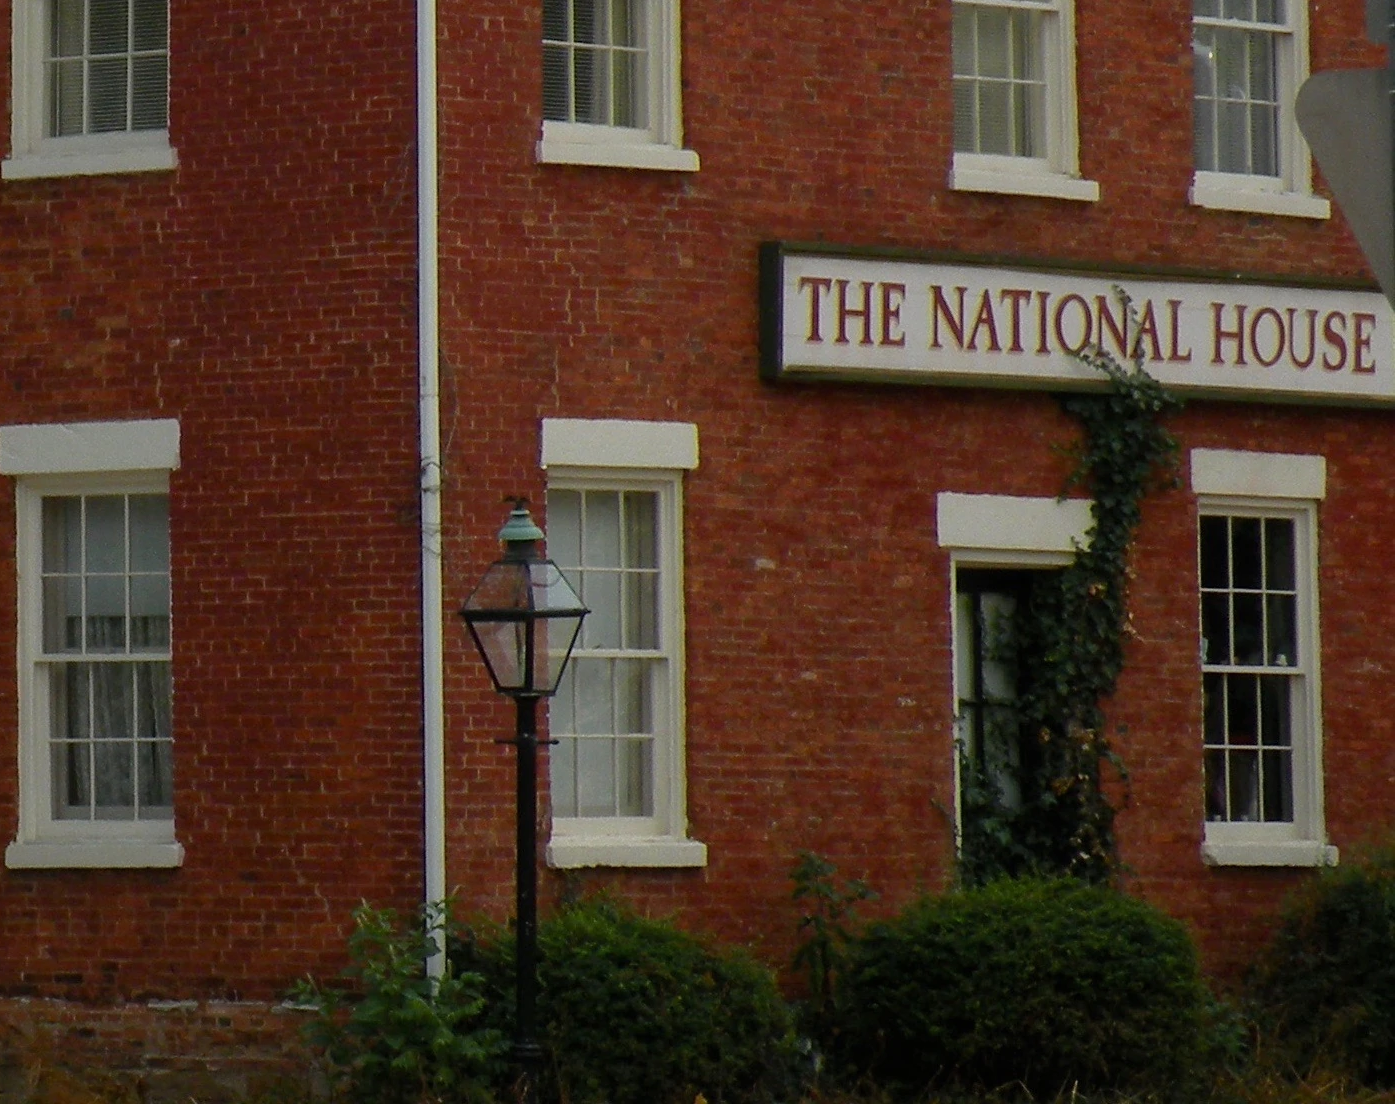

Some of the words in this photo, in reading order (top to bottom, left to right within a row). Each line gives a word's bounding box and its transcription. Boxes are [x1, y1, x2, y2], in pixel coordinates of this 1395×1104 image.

[798, 276, 906, 346] THE
[930, 284, 1193, 364] NATIONAL
[1210, 301, 1377, 375] HOUSE
